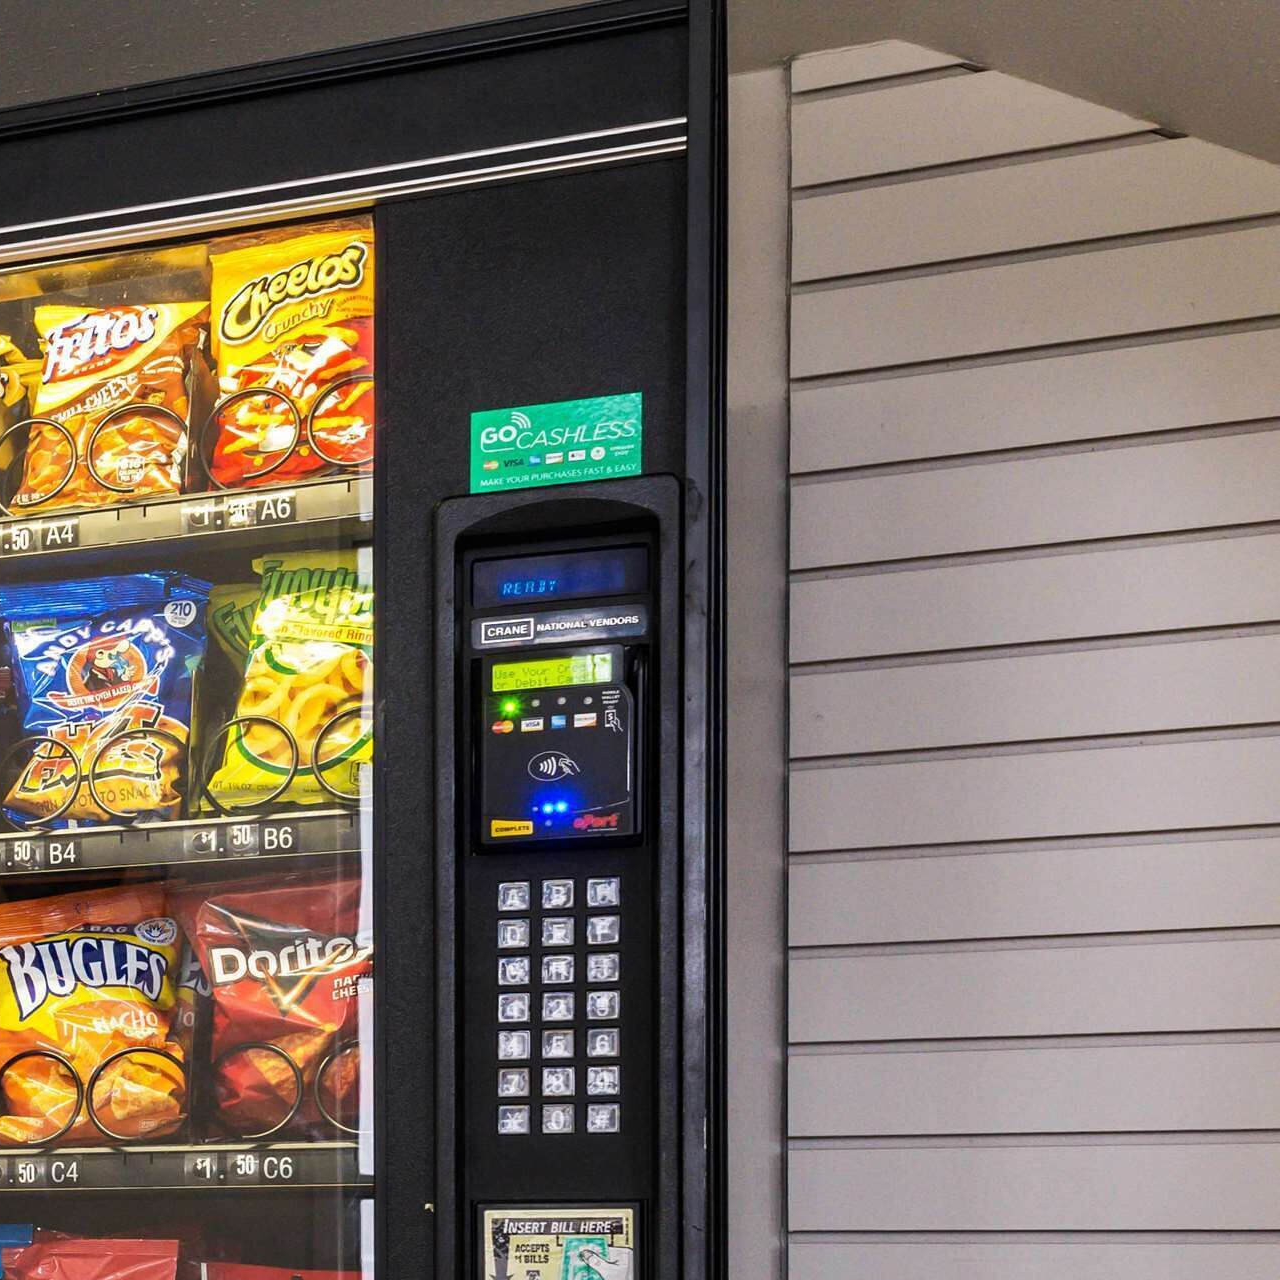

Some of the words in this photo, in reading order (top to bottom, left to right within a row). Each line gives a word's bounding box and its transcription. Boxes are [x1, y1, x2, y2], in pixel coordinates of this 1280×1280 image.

[221, 243, 368, 343] Cheetos
[262, 298, 332, 344] Crunchy
[42, 306, 159, 384] Fritos
[481, 426, 517, 444] GO
[516, 420, 636, 449] CASHLESS
[480, 477, 503, 487] MAKE
[506, 474, 529, 484] YOUR
[531, 469, 582, 482] PURCHASES
[583, 466, 604, 476] FAST
[606, 466, 613, 474] &
[615, 463, 636, 473] EASY
[46, 524, 74, 545] A4
[502, 580, 557, 595] READY
[170, 602, 192, 616] 210
[488, 625, 528, 637] CRANE
[537, 619, 586, 632] NATIONAL
[589, 615, 639, 628] VENDORS
[264, 828, 293, 848] B6
[52, 1162, 78, 1181] C4
[264, 1158, 293, 1178] C6
[503, 1218, 547, 1234] INSERT
[550, 1222, 575, 1233] BILL
[580, 1222, 611, 1233] HERE
[515, 1244, 550, 1252] ACCEPTS
